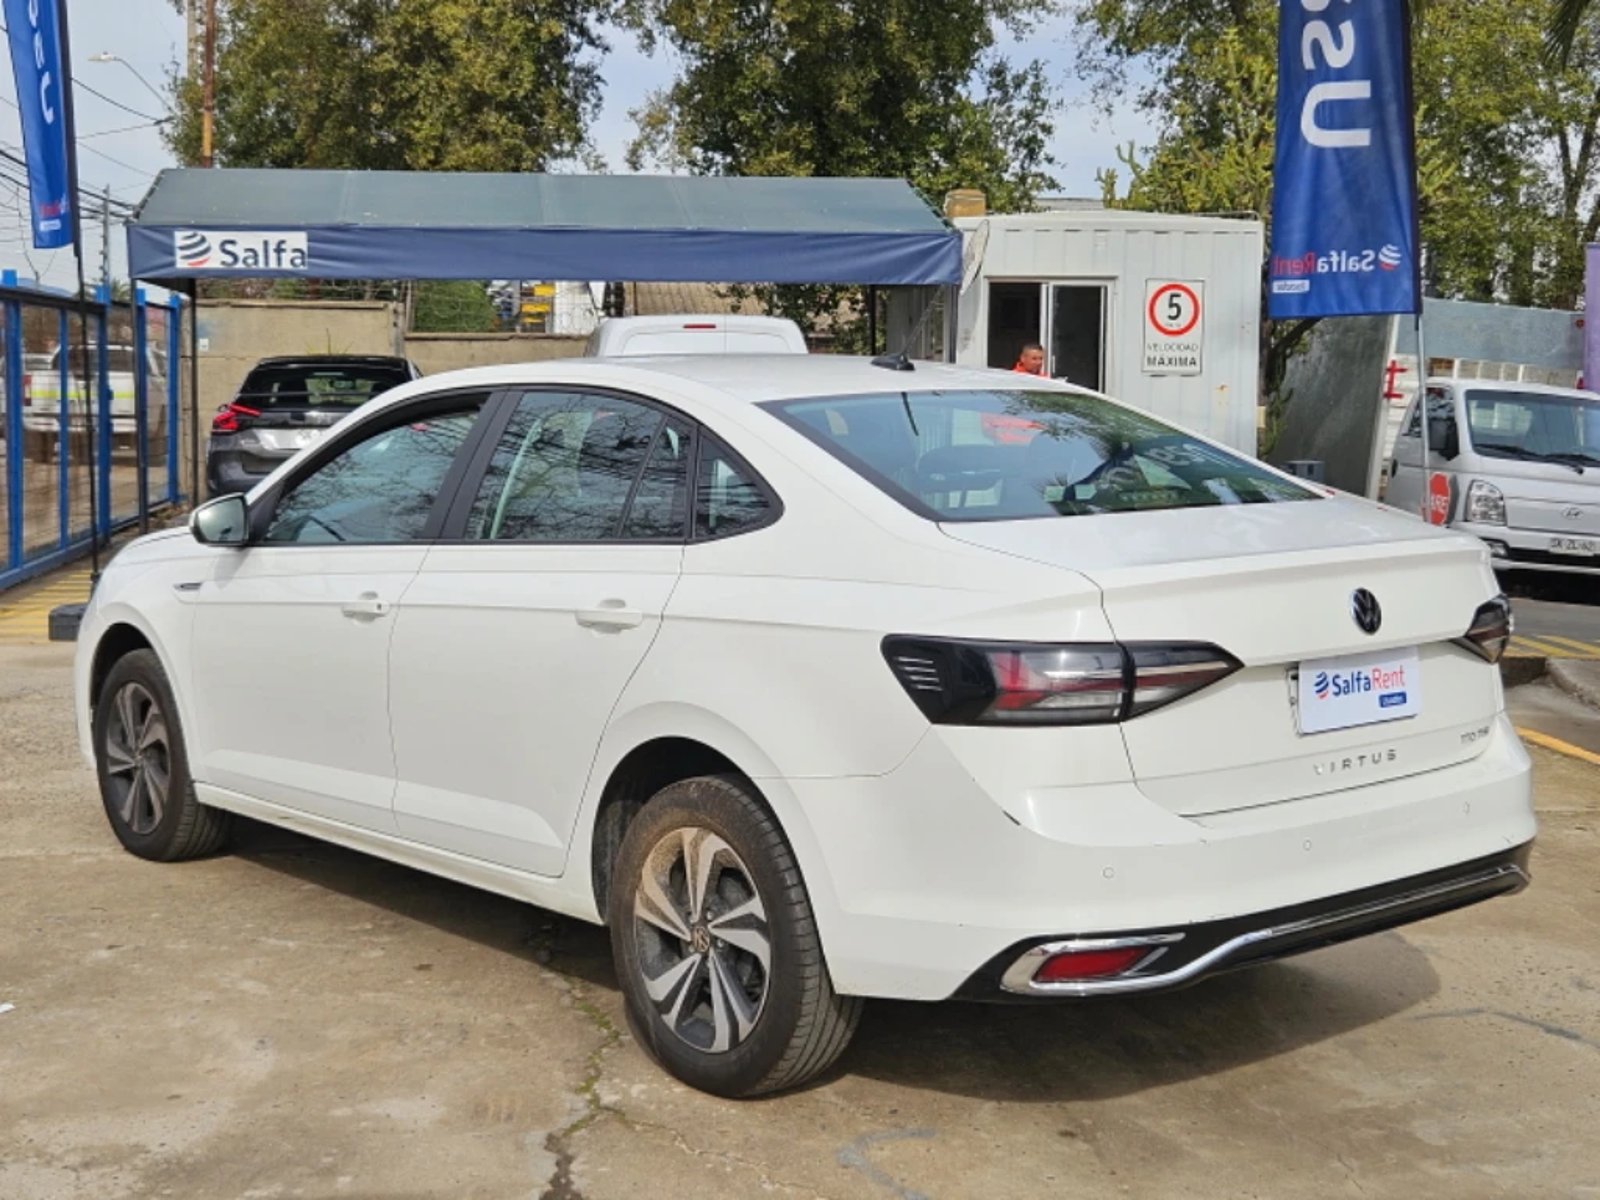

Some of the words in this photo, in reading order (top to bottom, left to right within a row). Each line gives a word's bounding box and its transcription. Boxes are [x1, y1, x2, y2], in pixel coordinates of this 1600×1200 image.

[219, 239, 307, 268] Salfa
[1167, 292, 1182, 321] 5
[1332, 664, 1405, 697] SalfaRent
[1313, 749, 1397, 776] VIRTUS
